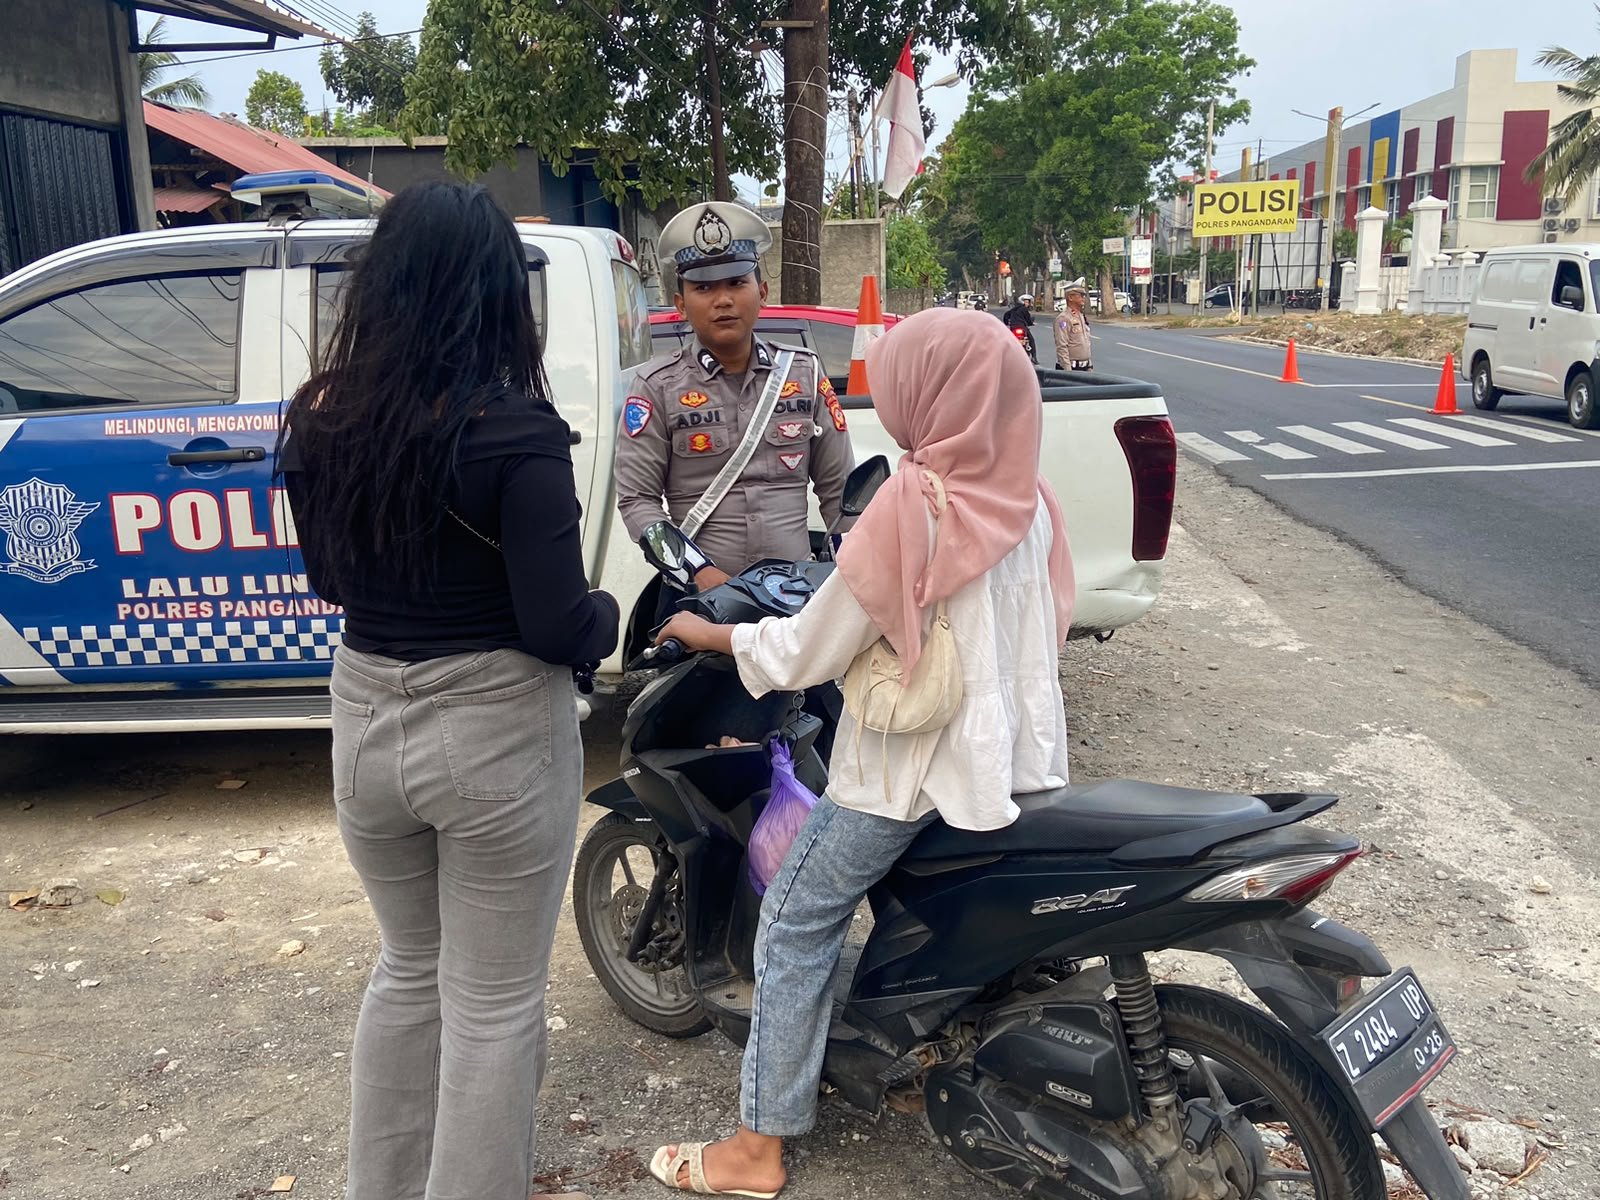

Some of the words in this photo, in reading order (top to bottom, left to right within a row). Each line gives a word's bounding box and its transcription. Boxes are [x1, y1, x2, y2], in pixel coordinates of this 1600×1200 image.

[1199, 189, 1294, 215] POLISI
[1196, 220, 1229, 229] POLRES
[1231, 218, 1295, 227] PANGANDARAN
[104, 417, 195, 436] MELINDUNGI,
[197, 414, 278, 433] MENGAYOMI
[677, 409, 721, 429] ADJI
[121, 575, 229, 599] LALU
[242, 574, 309, 595] LIN
[117, 601, 214, 621] POLRES
[1335, 1041, 1361, 1078] Z
[1354, 1009, 1398, 1063] 2484
[1399, 983, 1425, 1021] UP
